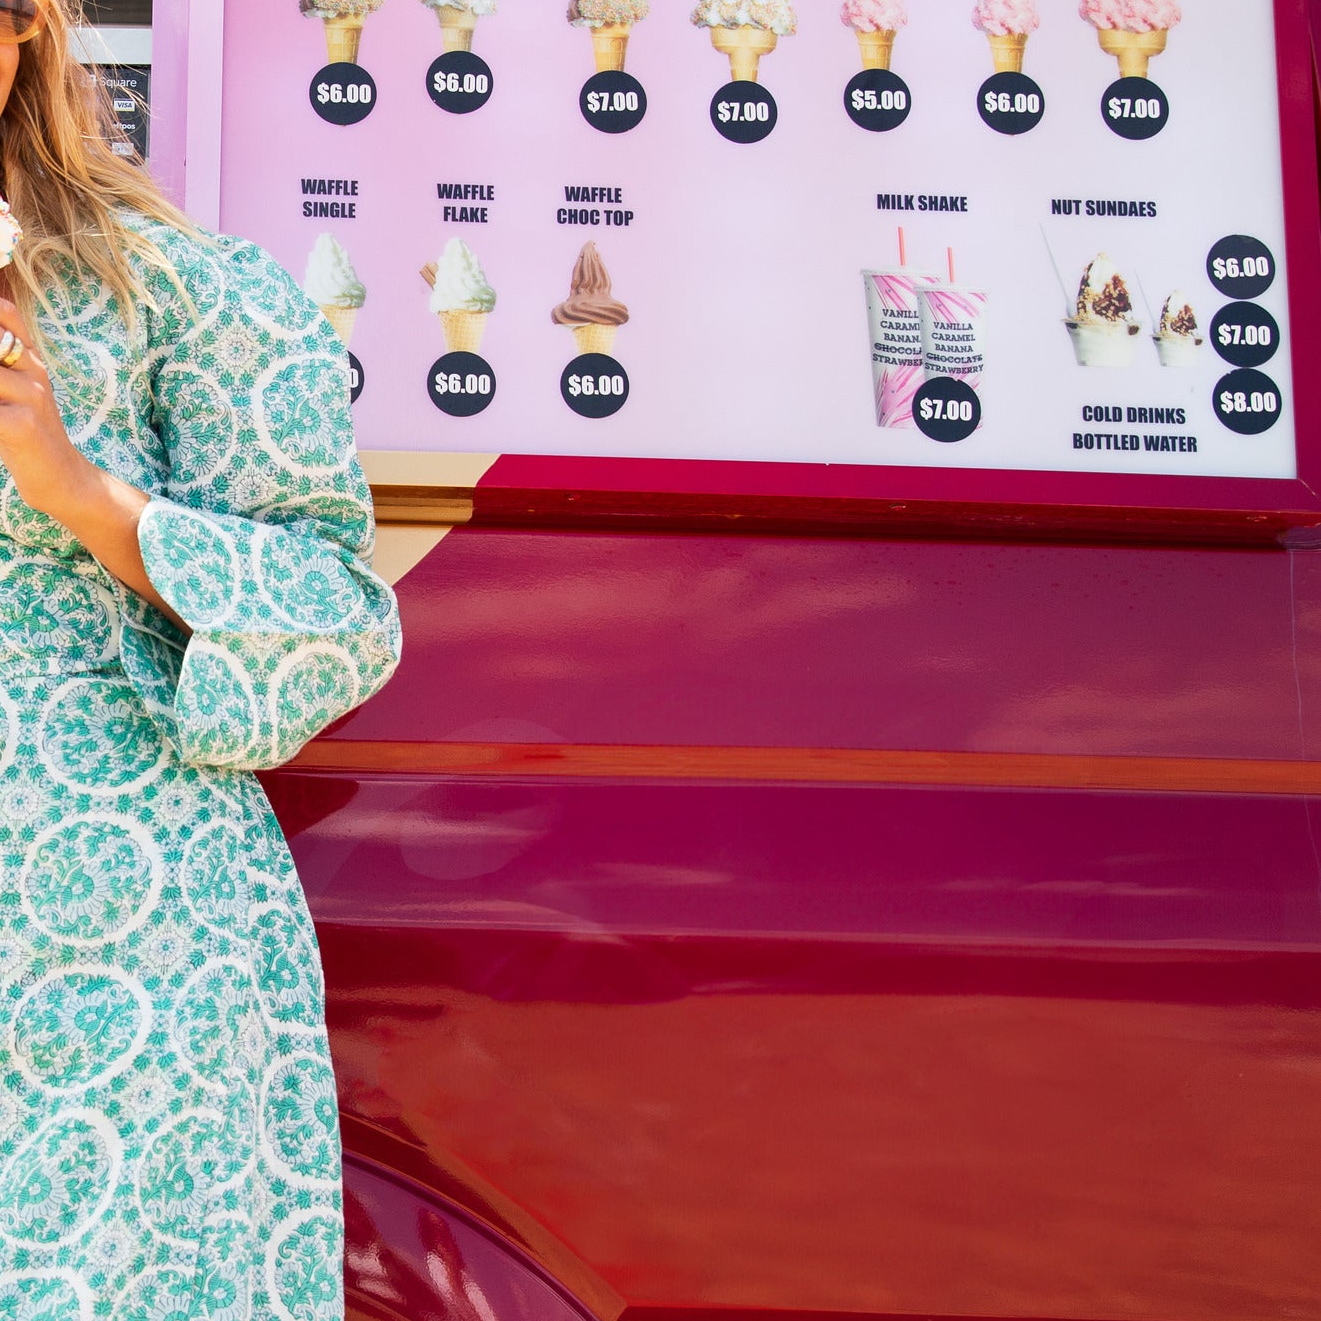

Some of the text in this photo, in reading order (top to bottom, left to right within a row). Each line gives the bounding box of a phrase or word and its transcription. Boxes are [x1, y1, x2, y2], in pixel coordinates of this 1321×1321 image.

[100, 77, 137, 88] Square
[434, 71, 488, 93] $6.00
[317, 83, 371, 104] $6.00
[587, 91, 638, 113] $7.00
[852, 89, 906, 110] $5.00
[985, 91, 1039, 113] $6.00
[718, 101, 768, 122] $7.00
[1109, 98, 1160, 119] $7.00
[301, 179, 358, 195] WAFFLE
[437, 184, 494, 200] WAFFLE
[565, 186, 622, 203] WAFFLE
[303, 201, 355, 218] SINGLE
[877, 194, 967, 211] MILK SHAKE
[1052, 200, 1156, 217] NUT SUNDAES
[444, 206, 487, 223] FLAKE
[557, 209, 633, 226] CHOC TOP
[1213, 257, 1269, 279] $6.00
[882, 309, 918, 318] VANILL
[934, 322, 973, 330] VANILLA
[1219, 324, 1270, 345] $7.00
[884, 333, 921, 343] BANAN
[932, 333, 975, 341] CARAMEL
[935, 344, 973, 353] BANANA
[925, 363, 983, 374] STRAWBERRY
[436, 372, 490, 394] $6.00
[569, 374, 623, 396] $6.00
[920, 398, 972, 421] $7.00
[1221, 391, 1276, 413] $8.00
[1083, 406, 1185, 424] COLD DRINKS
[1073, 433, 1197, 452] BOTTLED WATER
